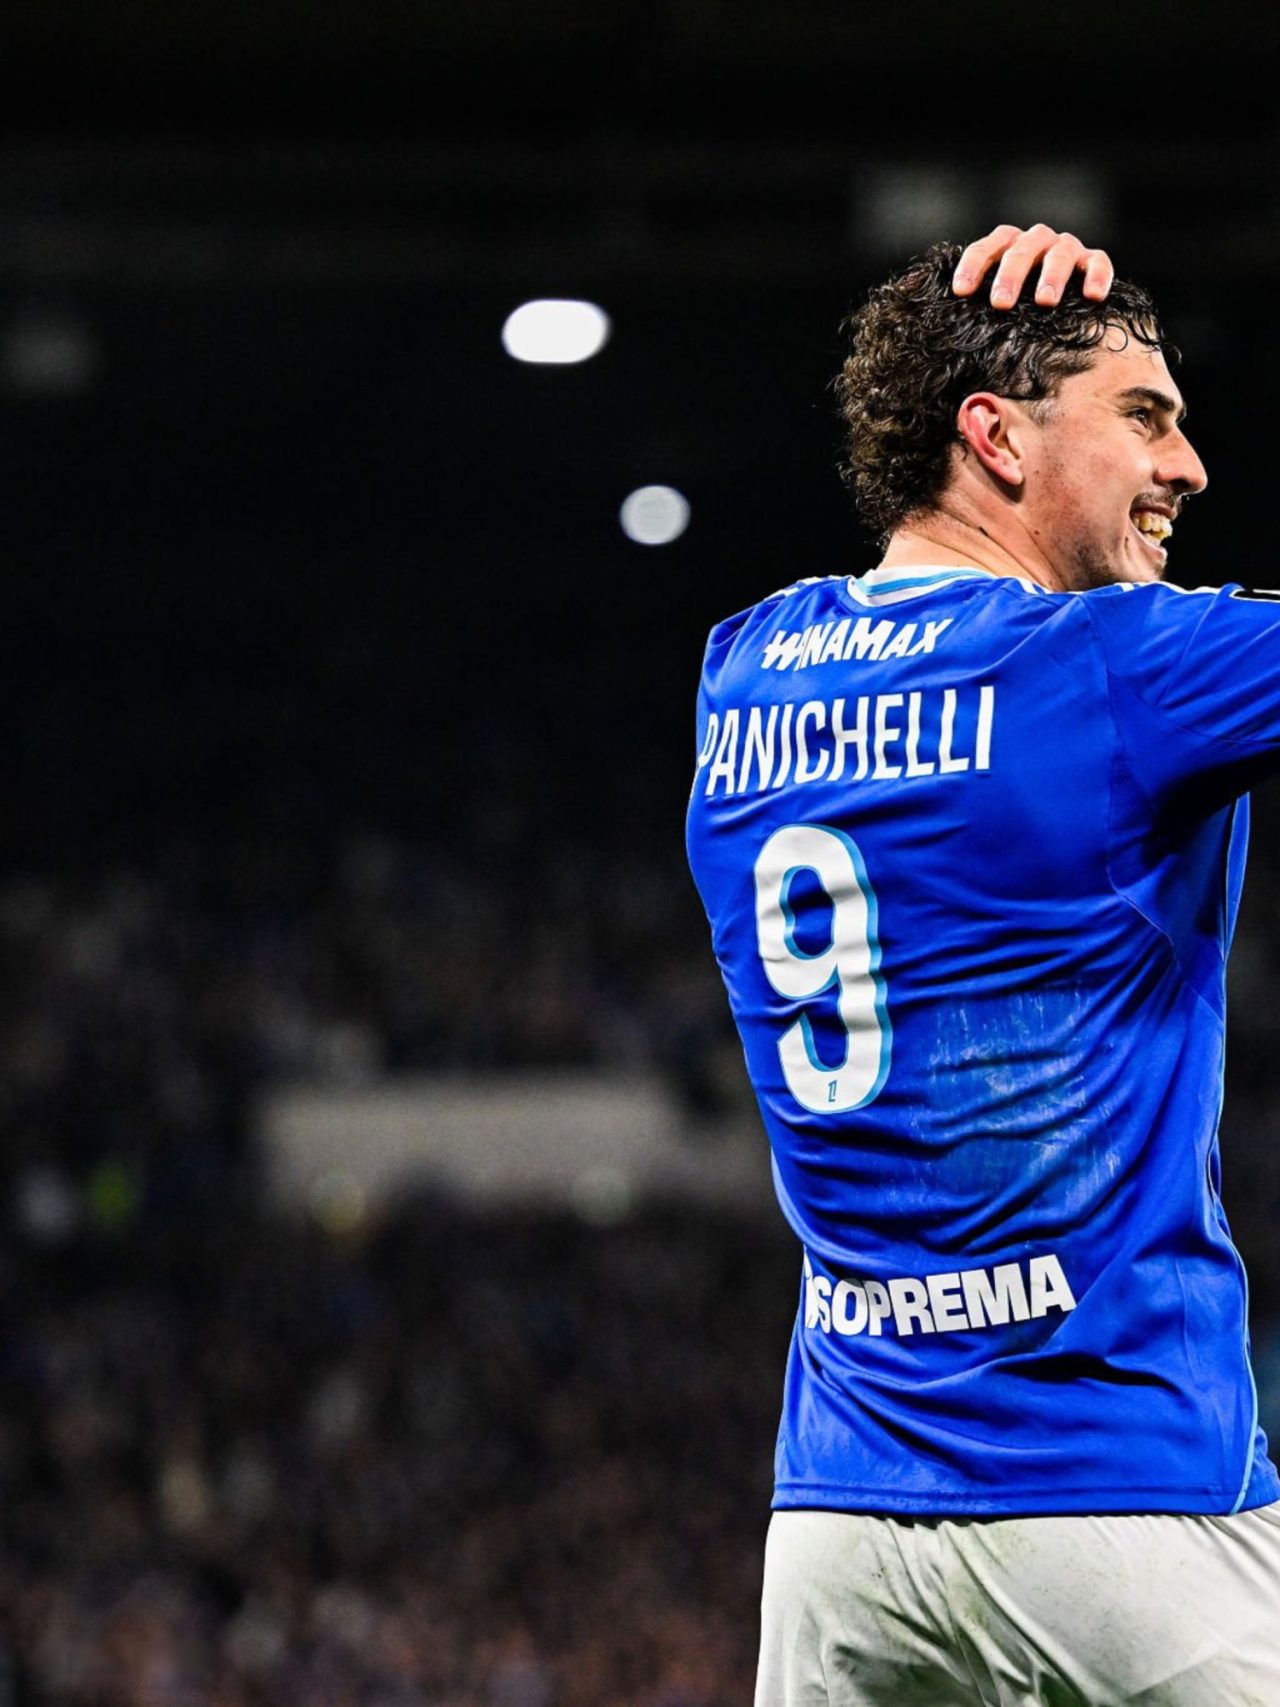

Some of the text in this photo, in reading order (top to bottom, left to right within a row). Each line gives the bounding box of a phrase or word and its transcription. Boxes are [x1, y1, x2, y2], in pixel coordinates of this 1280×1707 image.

[699, 685, 994, 796] PANICHELLI
[754, 824, 892, 1114] 9
[812, 1253, 1076, 1336] SOPREMA
